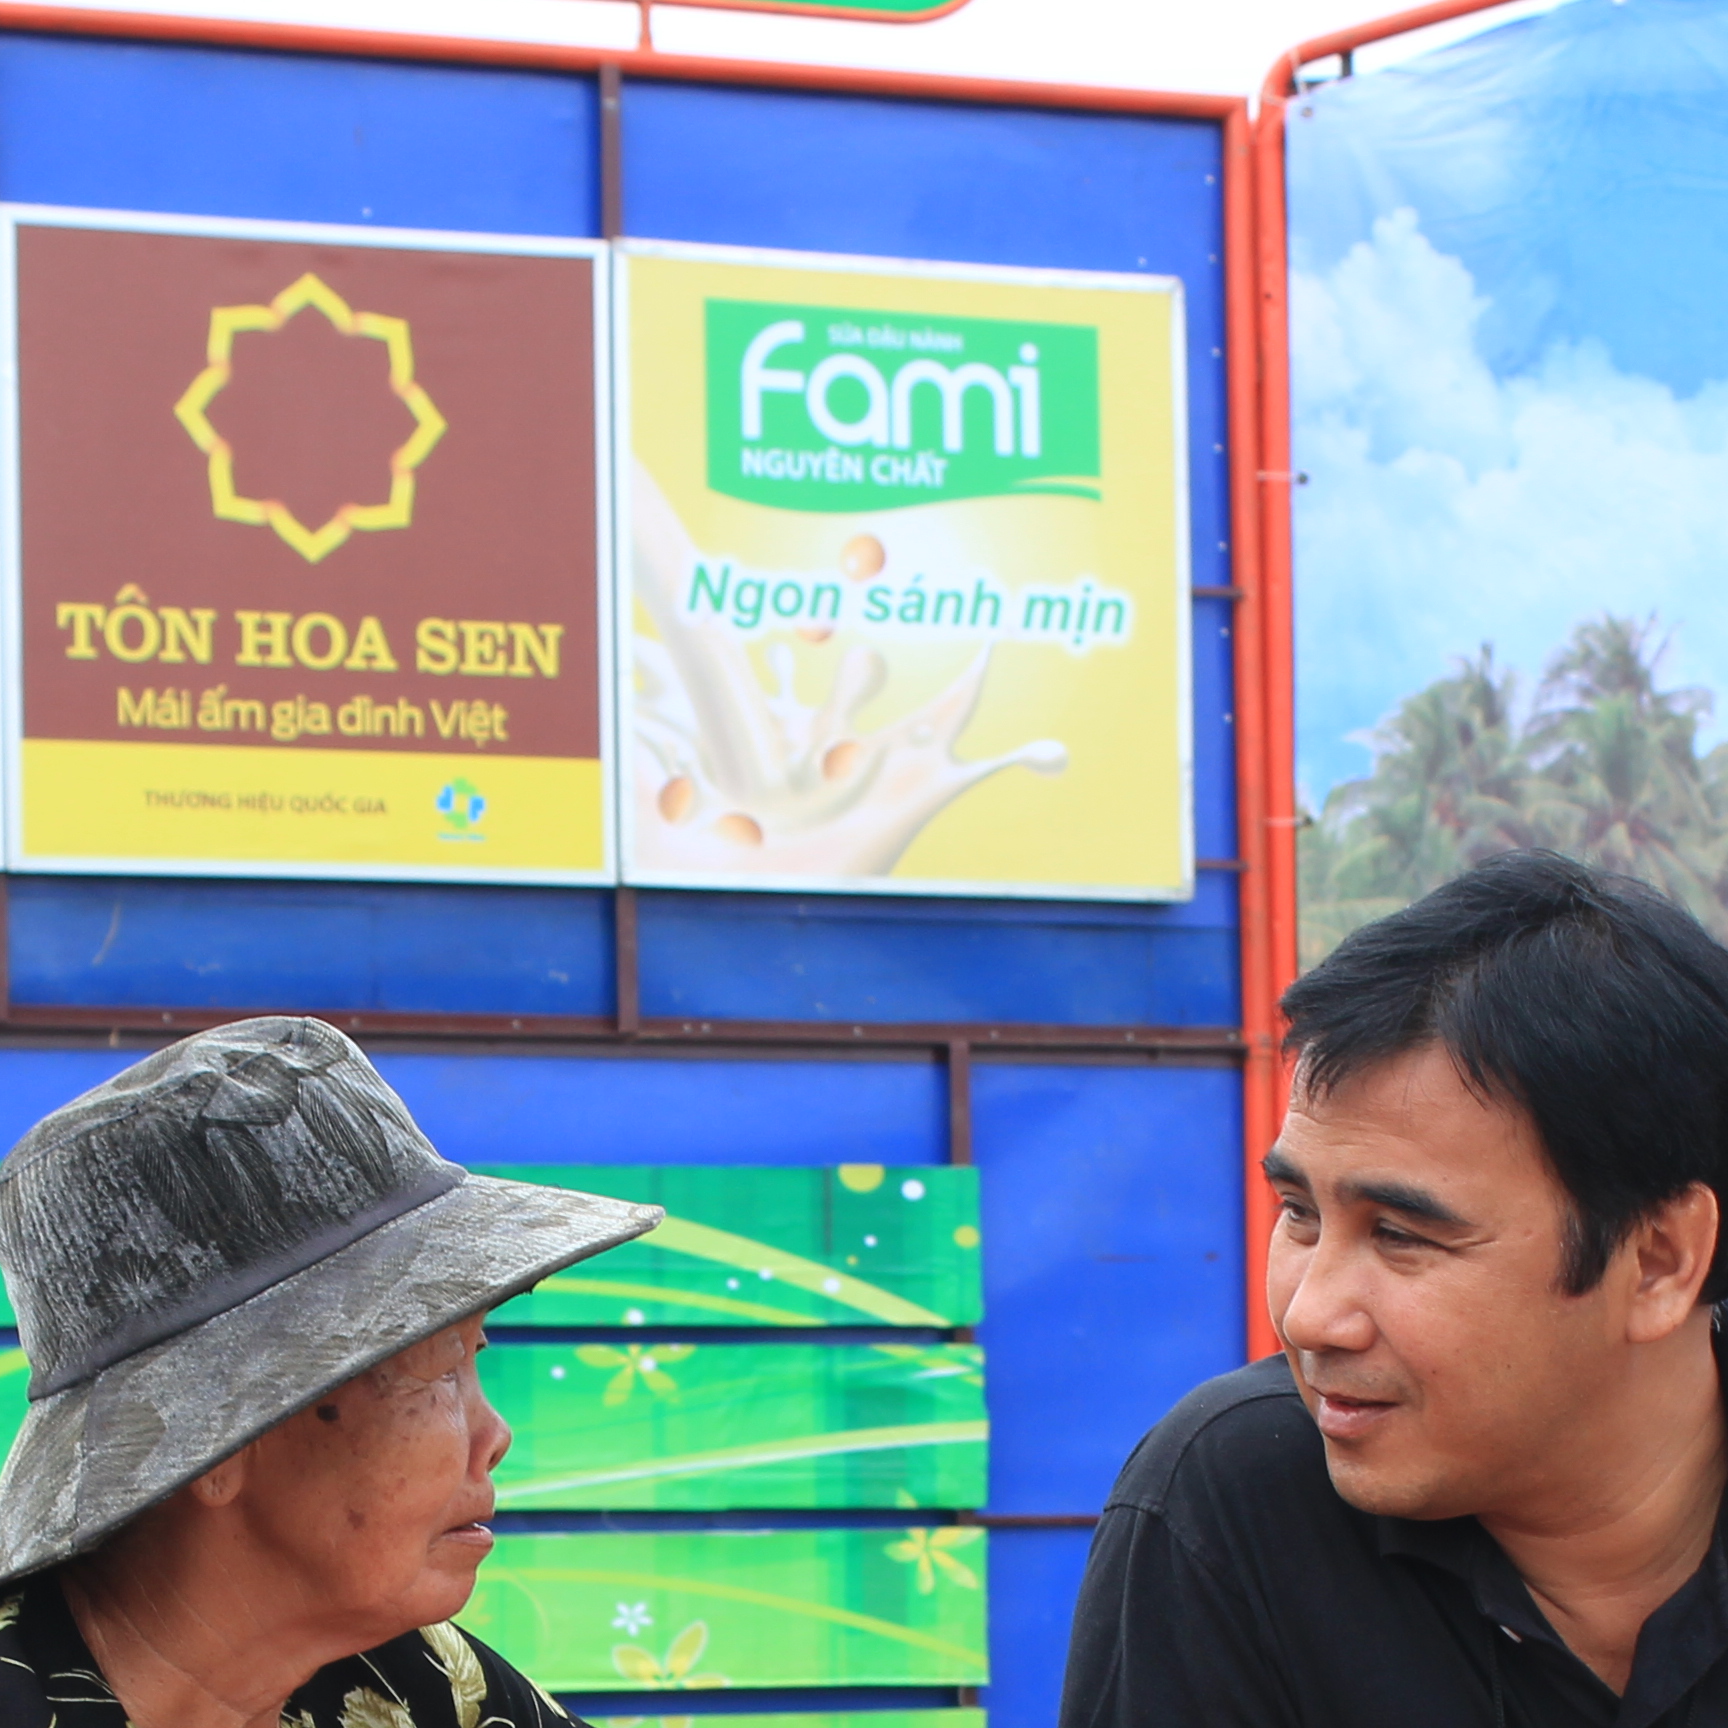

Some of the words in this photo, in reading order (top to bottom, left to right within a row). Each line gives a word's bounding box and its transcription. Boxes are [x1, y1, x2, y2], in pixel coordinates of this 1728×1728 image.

[742, 445, 864, 484] NGUYÊN
[870, 450, 948, 489] CHẤT
[57, 583, 216, 665] TÔN
[234, 609, 398, 672] HOA
[415, 617, 564, 678] SEN
[687, 562, 843, 630] Ngon
[863, 573, 1002, 628] sánh
[1022, 584, 1127, 647] mịn
[117, 686, 191, 729] Mái
[197, 683, 266, 731] ấm
[271, 694, 333, 741] gia
[337, 694, 426, 739] đình
[429, 699, 509, 748] Việt
[353, 794, 388, 818] GIA
